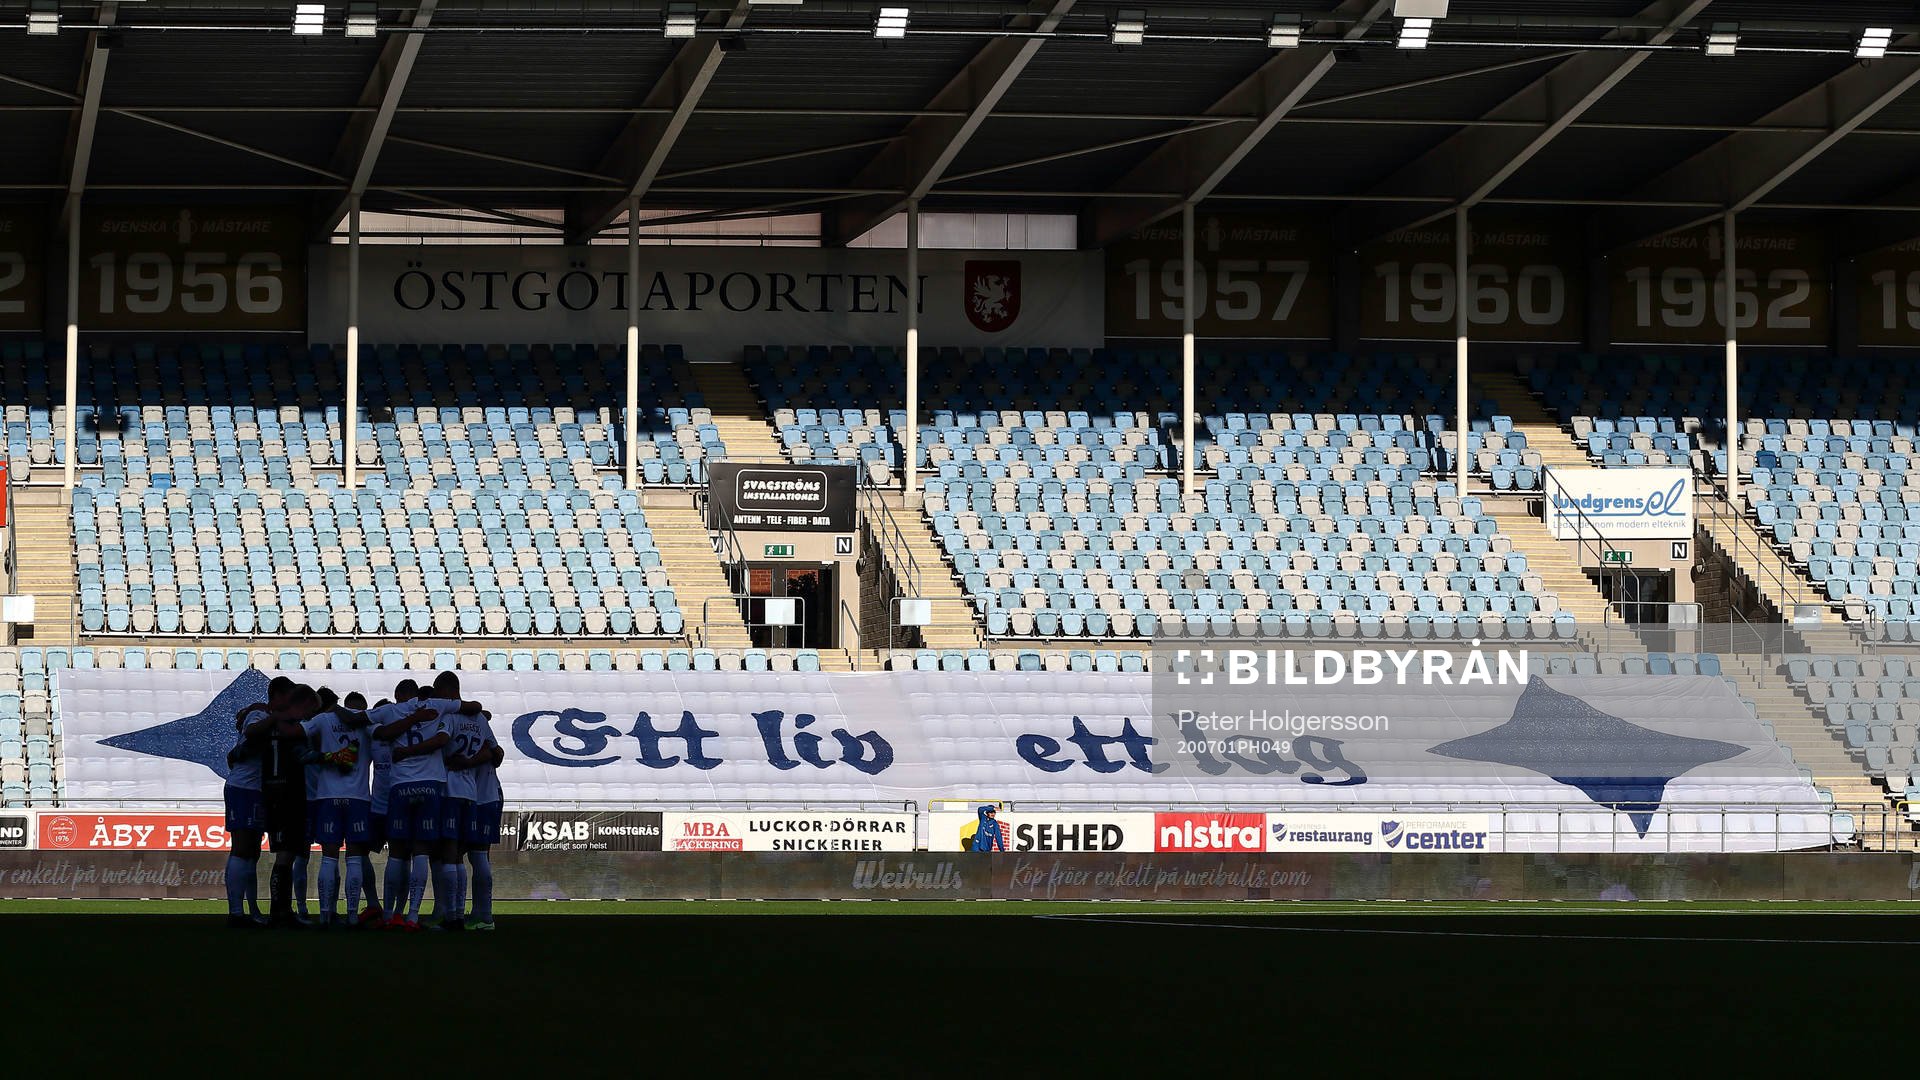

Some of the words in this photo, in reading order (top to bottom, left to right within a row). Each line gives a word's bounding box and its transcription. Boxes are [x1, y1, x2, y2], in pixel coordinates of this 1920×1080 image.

[101, 220, 167, 233] SVENSKA
[1132, 227, 1192, 241] SVENSK
[91, 251, 283, 314] 1956
[394, 261, 928, 314] ÖSTGÖTAPORTEN
[1124, 258, 1311, 321] 1957
[1374, 261, 1565, 325] 1960
[1625, 266, 1811, 329] 1962
[743, 478, 821, 491] SVAGSTRÖMS
[743, 491, 820, 501] INSTALLATIONER
[733, 515, 761, 524] ANTENN
[766, 515, 782, 525] TELE
[787, 516, 807, 525] FIBER
[812, 516, 830, 526] DATA
[1616, 520, 1649, 529] modern
[1651, 520, 1686, 529] elteknik
[839, 538, 850, 553] N
[1674, 544, 1686, 557] N
[511, 707, 723, 769] Ett
[750, 710, 894, 774] liv
[1016, 715, 1170, 773] ett
[1167, 711, 1368, 786] lag
[89, 816, 155, 847] ÅBY
[166, 824, 231, 848] FAS
[527, 821, 589, 841] KSAB
[597, 825, 660, 836] KONSTGRÄS
[683, 822, 730, 837] MBA
[1406, 821, 1468, 829] PERFORMANCE
[55, 835, 69, 843] 1976
[1016, 823, 1124, 852] SEHED
[1160, 820, 1261, 849] nistra
[1289, 830, 1373, 845] restaurang
[1405, 830, 1487, 849] center
[673, 840, 740, 849] LACKERING
[772, 839, 882, 850] SNICKERIER
[11, 859, 71, 885] enkelt
[71, 863, 98, 891] på
[851, 859, 962, 889] Weibulls
[1010, 857, 1047, 892] Köp
[1047, 859, 1093, 899] fröer
[1095, 861, 1153, 888] enkelt
[1153, 866, 1180, 893] på
[1184, 862, 1312, 888] weibulls.com
